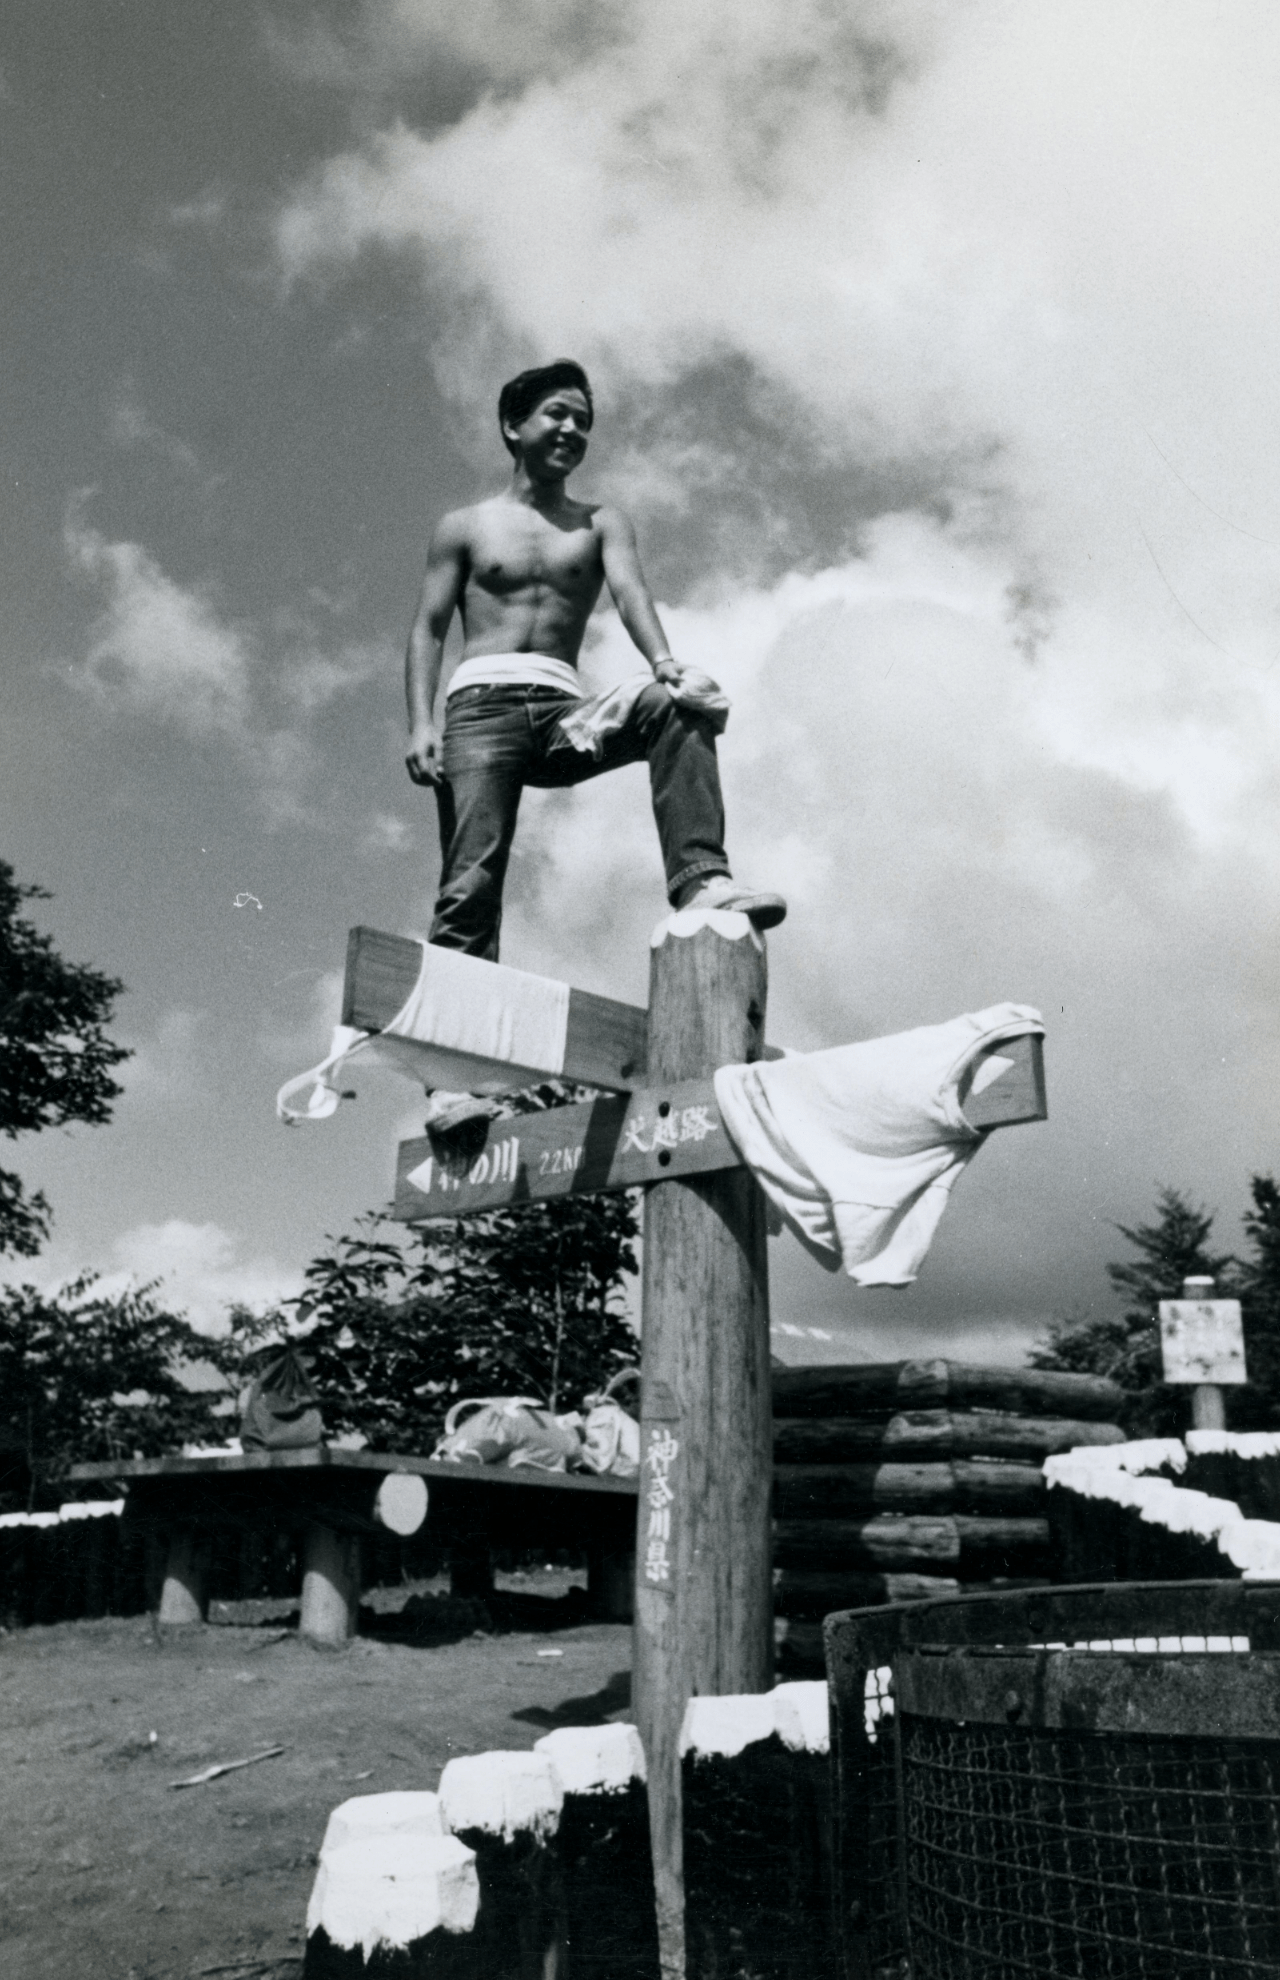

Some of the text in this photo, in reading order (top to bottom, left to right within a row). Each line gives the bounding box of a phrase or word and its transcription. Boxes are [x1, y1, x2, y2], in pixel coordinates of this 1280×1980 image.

[620, 1105, 719, 1154] 犬越路
[645, 1428, 679, 1583] 神奈川県
